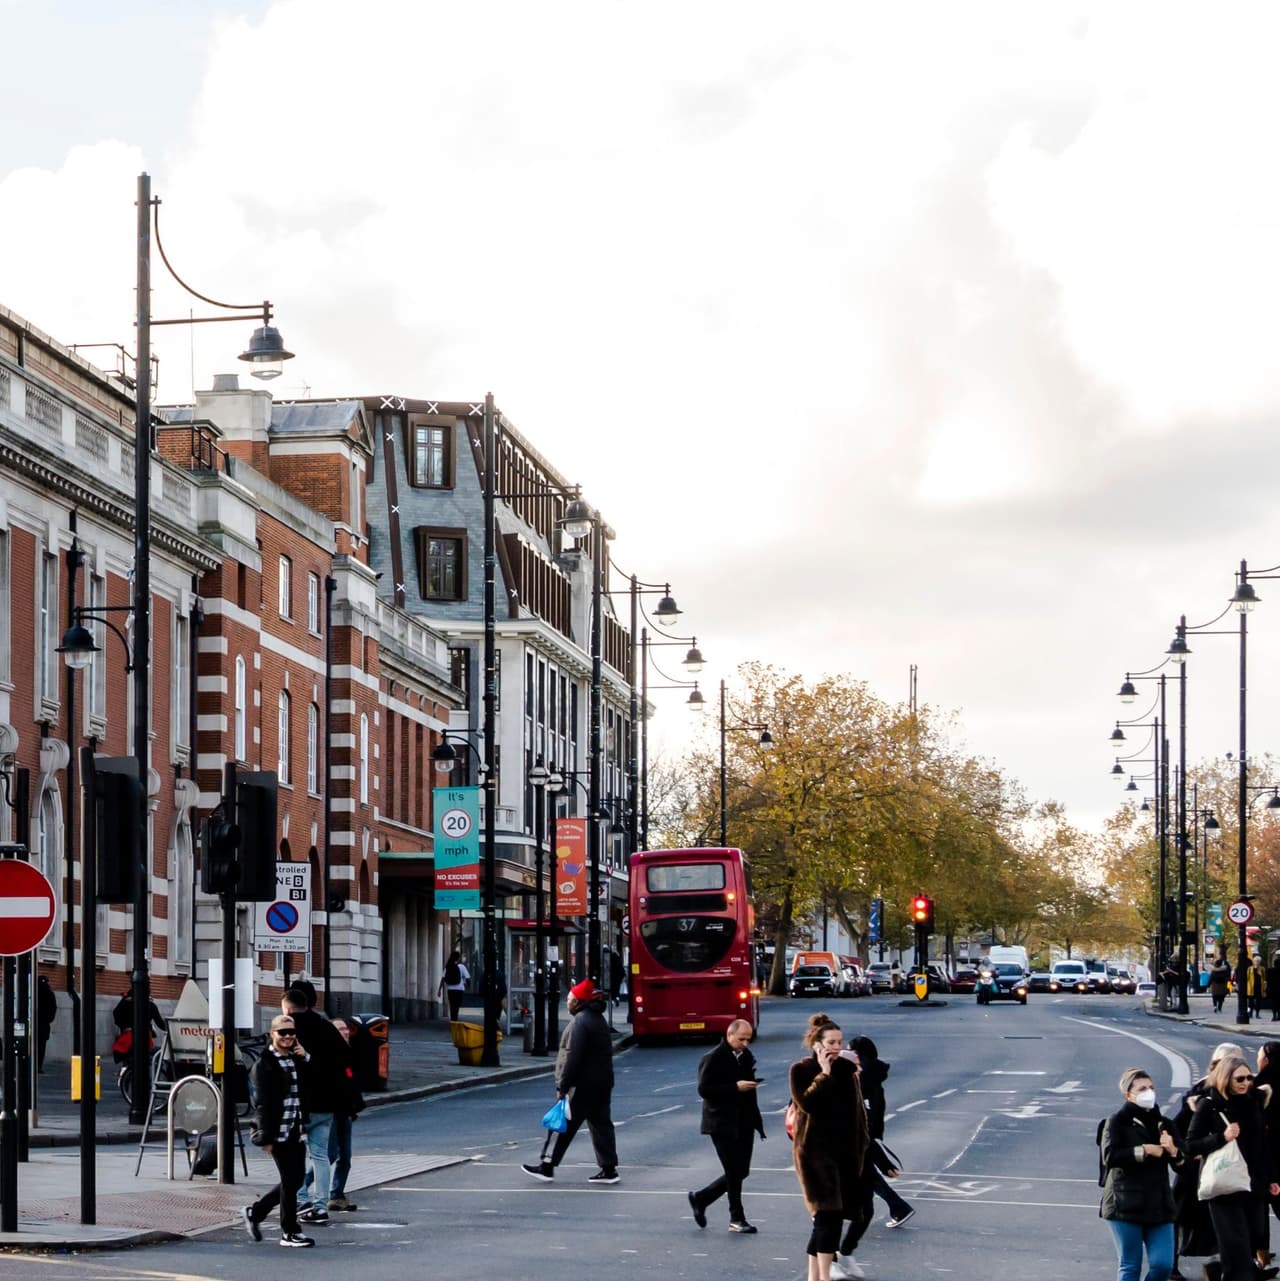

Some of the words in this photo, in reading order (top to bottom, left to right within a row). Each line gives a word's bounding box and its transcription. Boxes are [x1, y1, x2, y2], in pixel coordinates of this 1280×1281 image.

[449, 792, 465, 801] It's
[447, 816, 467, 830] 20
[445, 846, 469, 856] mph
[276, 877, 292, 885] NE
[1231, 908, 1248, 918] 20
[679, 919, 696, 932] 37
[180, 1026, 215, 1036] metro
